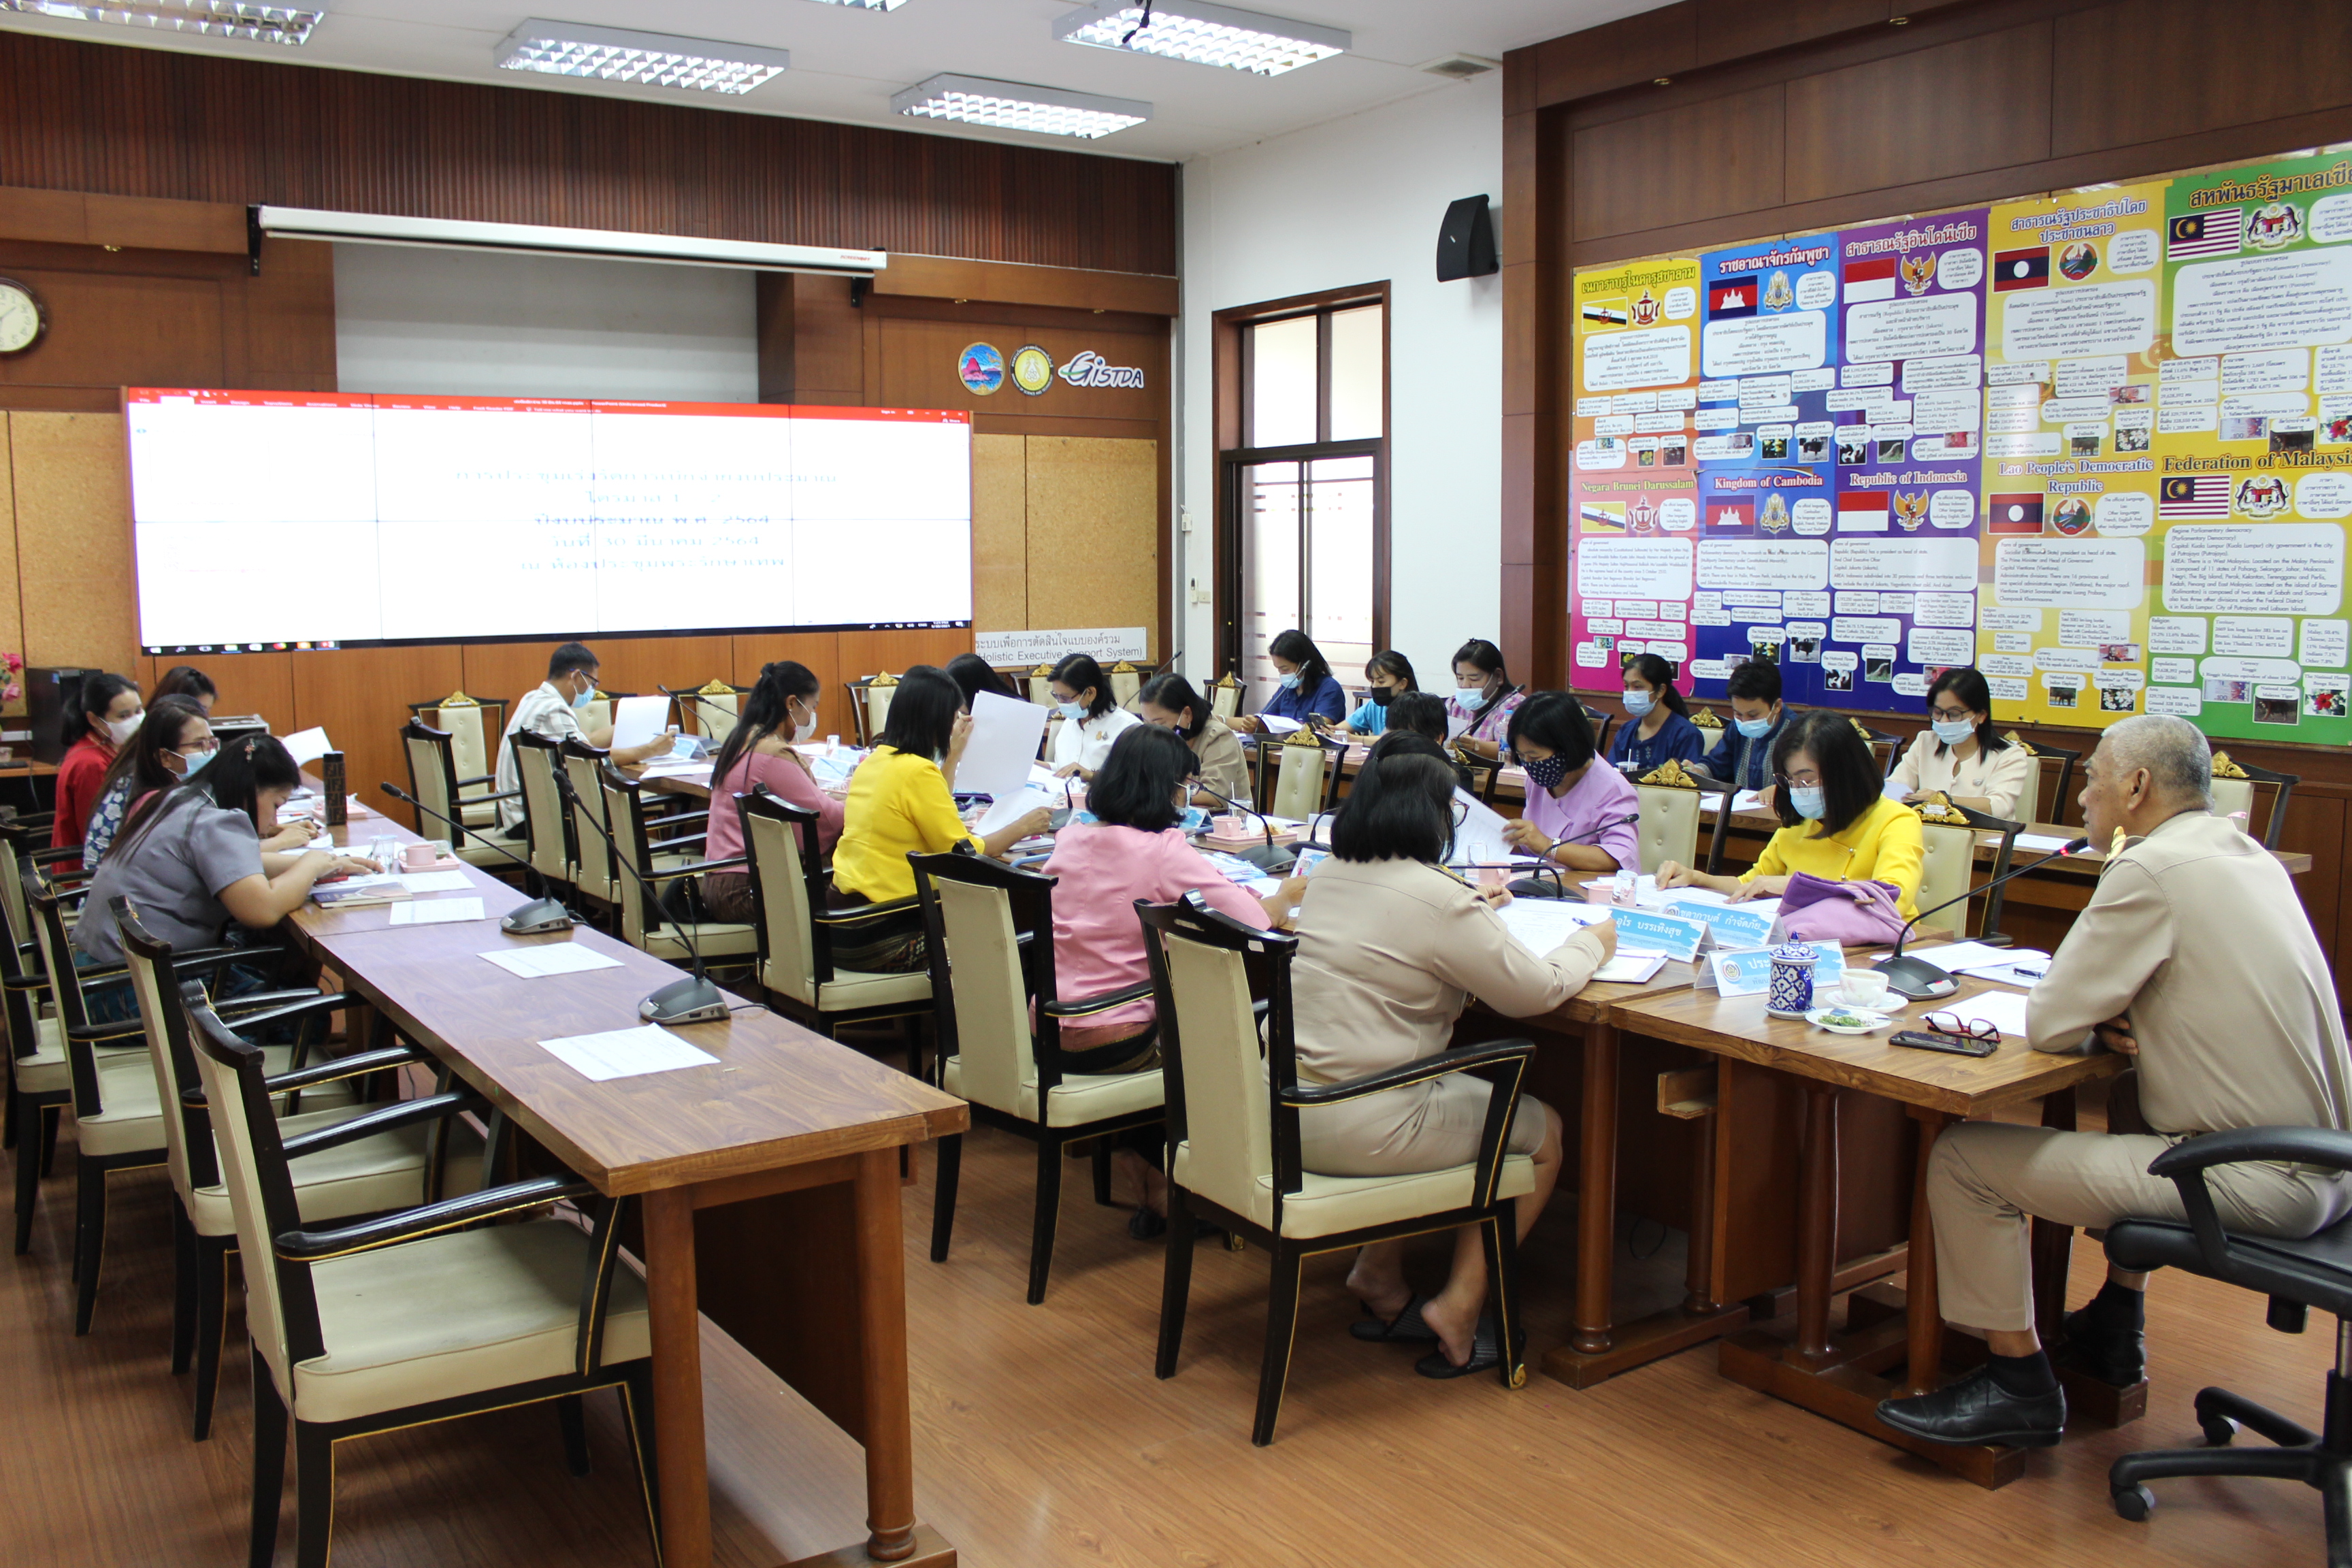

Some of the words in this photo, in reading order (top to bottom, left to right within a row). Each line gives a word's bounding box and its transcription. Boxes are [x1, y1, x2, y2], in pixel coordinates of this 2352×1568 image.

[2011, 196, 2146, 231] สาธารณรัฐประชาธิปไตย
[2040, 222, 2114, 244] ประชาชนลาว
[1719, 246, 1829, 274] ราชอาณาจักรกัมพูชา
[1999, 462, 2023, 476] Lao
[2078, 457, 2153, 474] Democratic
[2163, 453, 2251, 473] Federation
[2257, 452, 2276, 469] of
[2281, 448, 2352, 470] Malaysi
[1582, 482, 1610, 493] Negara
[1613, 481, 1641, 491] Brunei
[1644, 479, 1694, 490] Darussalam
[1714, 477, 1757, 491] Kingdom
[1761, 476, 1771, 487] of
[1774, 475, 1823, 487] Cambodia
[1850, 472, 1897, 488] Republic
[1900, 472, 1912, 484] of
[1914, 470, 1967, 483] Indonesia
[2048, 480, 2103, 495] Republic
[602, 537, 626, 547] 30
[636, 534, 702, 547] มีนาคม
[712, 536, 759, 546] 2564
[976, 632, 1120, 649] ระบบเพื่อการตัดสินใจแบบองค์รวม
[1018, 649, 1062, 661] Executive
[1107, 647, 1142, 658] System)
